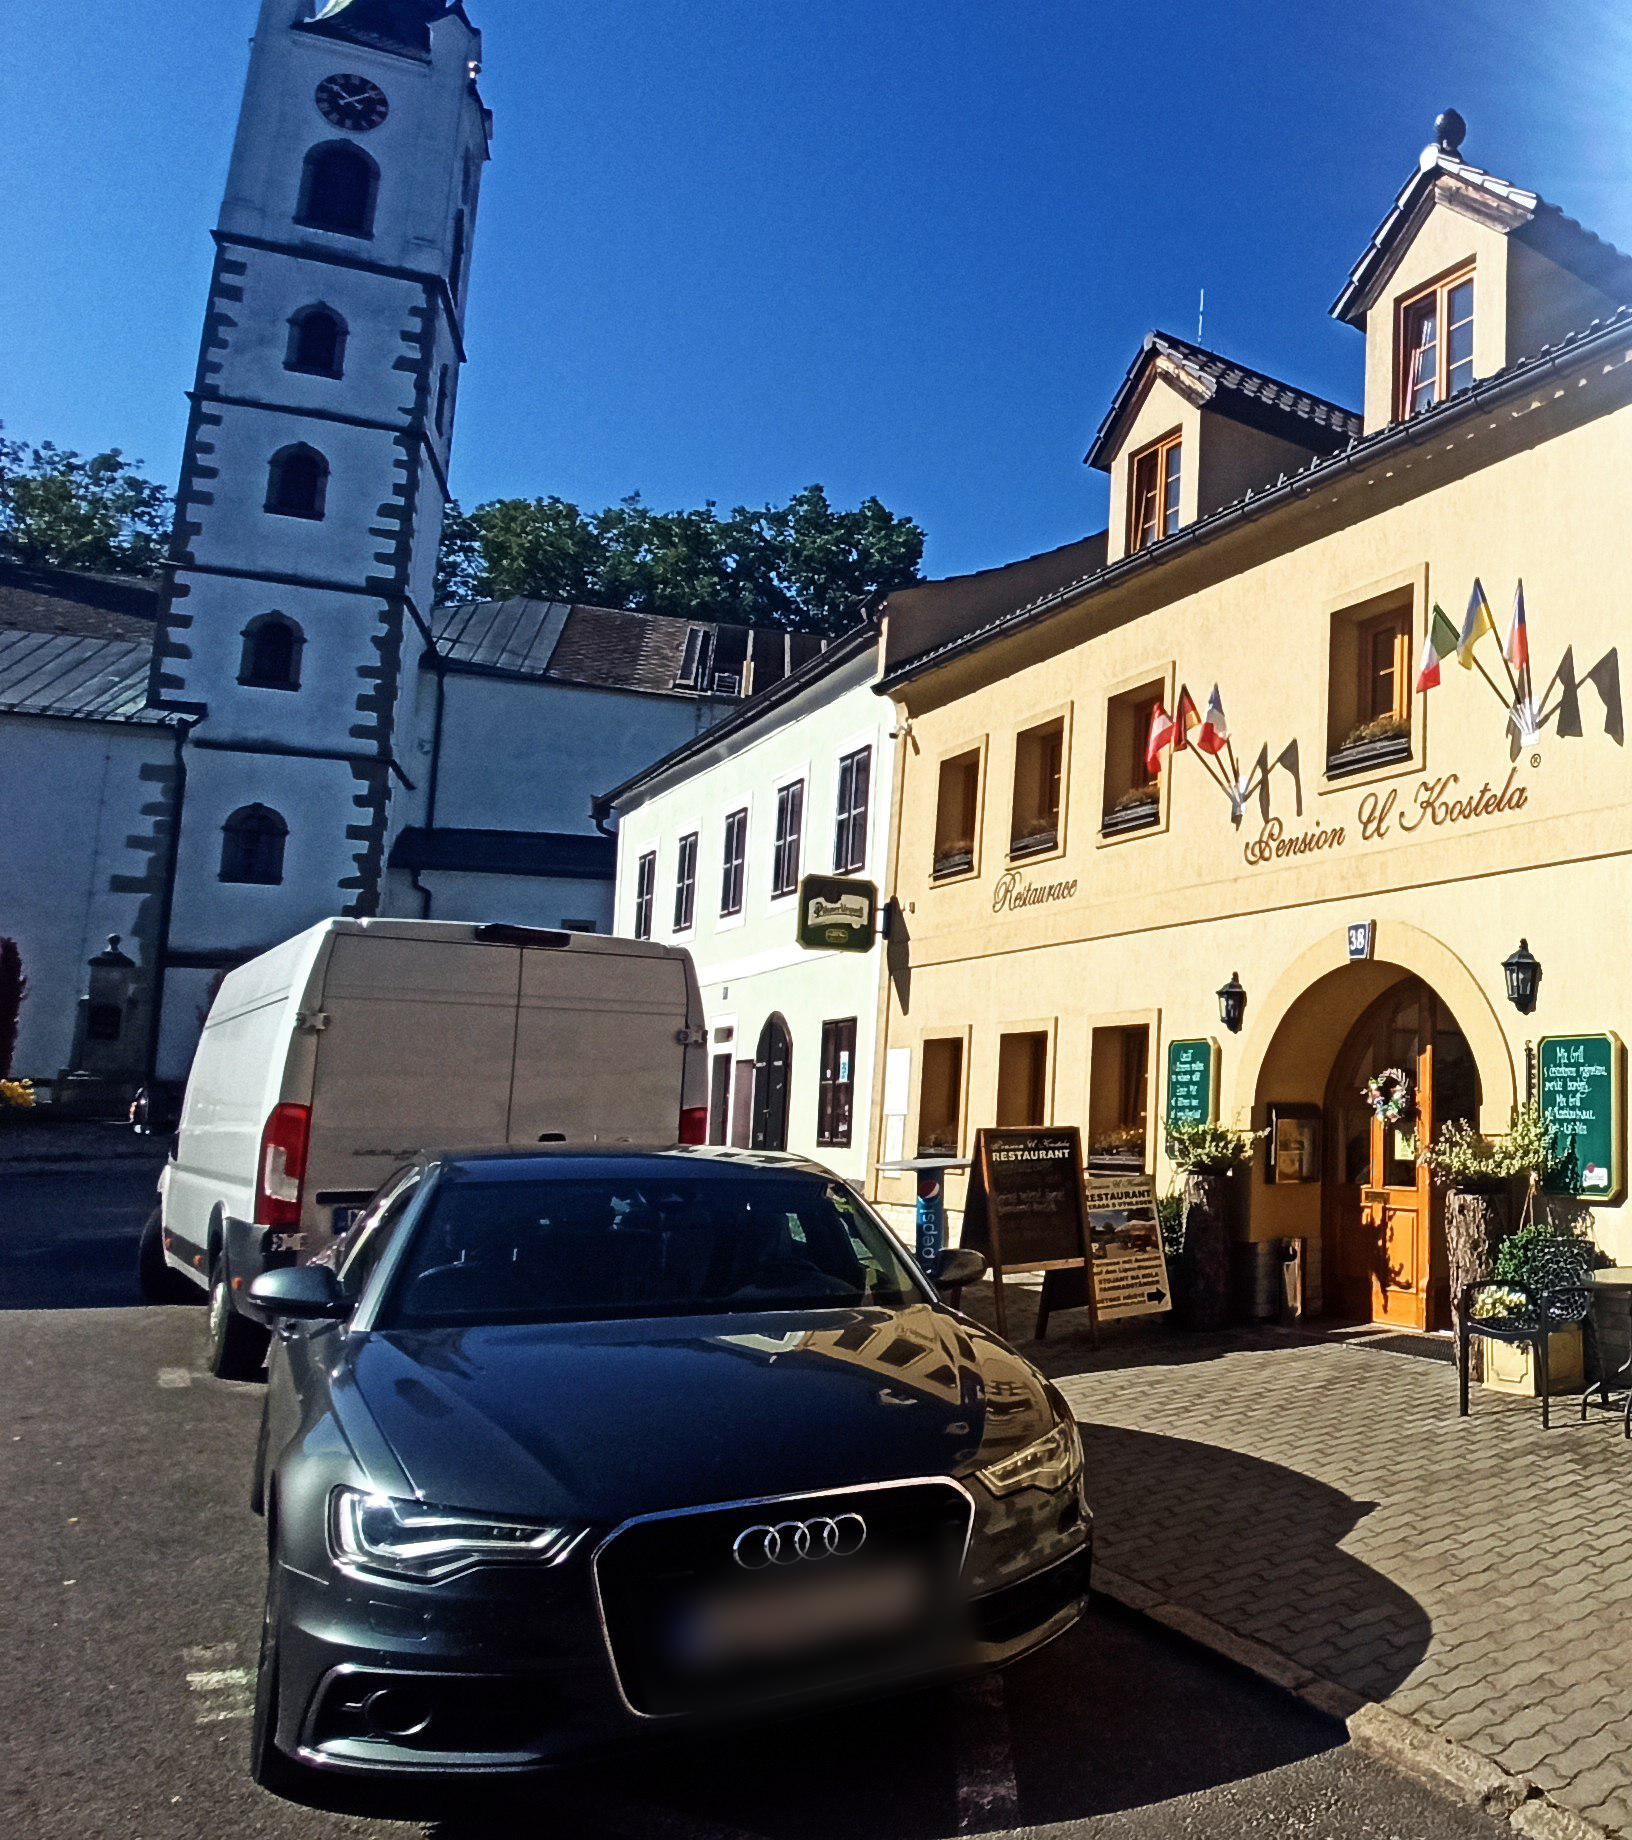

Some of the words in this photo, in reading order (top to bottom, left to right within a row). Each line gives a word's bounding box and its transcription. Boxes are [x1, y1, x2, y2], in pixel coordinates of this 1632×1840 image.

[1244, 816, 1346, 865] Pension
[1357, 788, 1398, 841] U
[1398, 765, 1529, 832] Kostela
[992, 870, 1078, 913] Restaurace
[1349, 928, 1365, 950] 38
[992, 1149, 1071, 1162] RESTAURANT
[921, 1206, 938, 1260] pepsi
